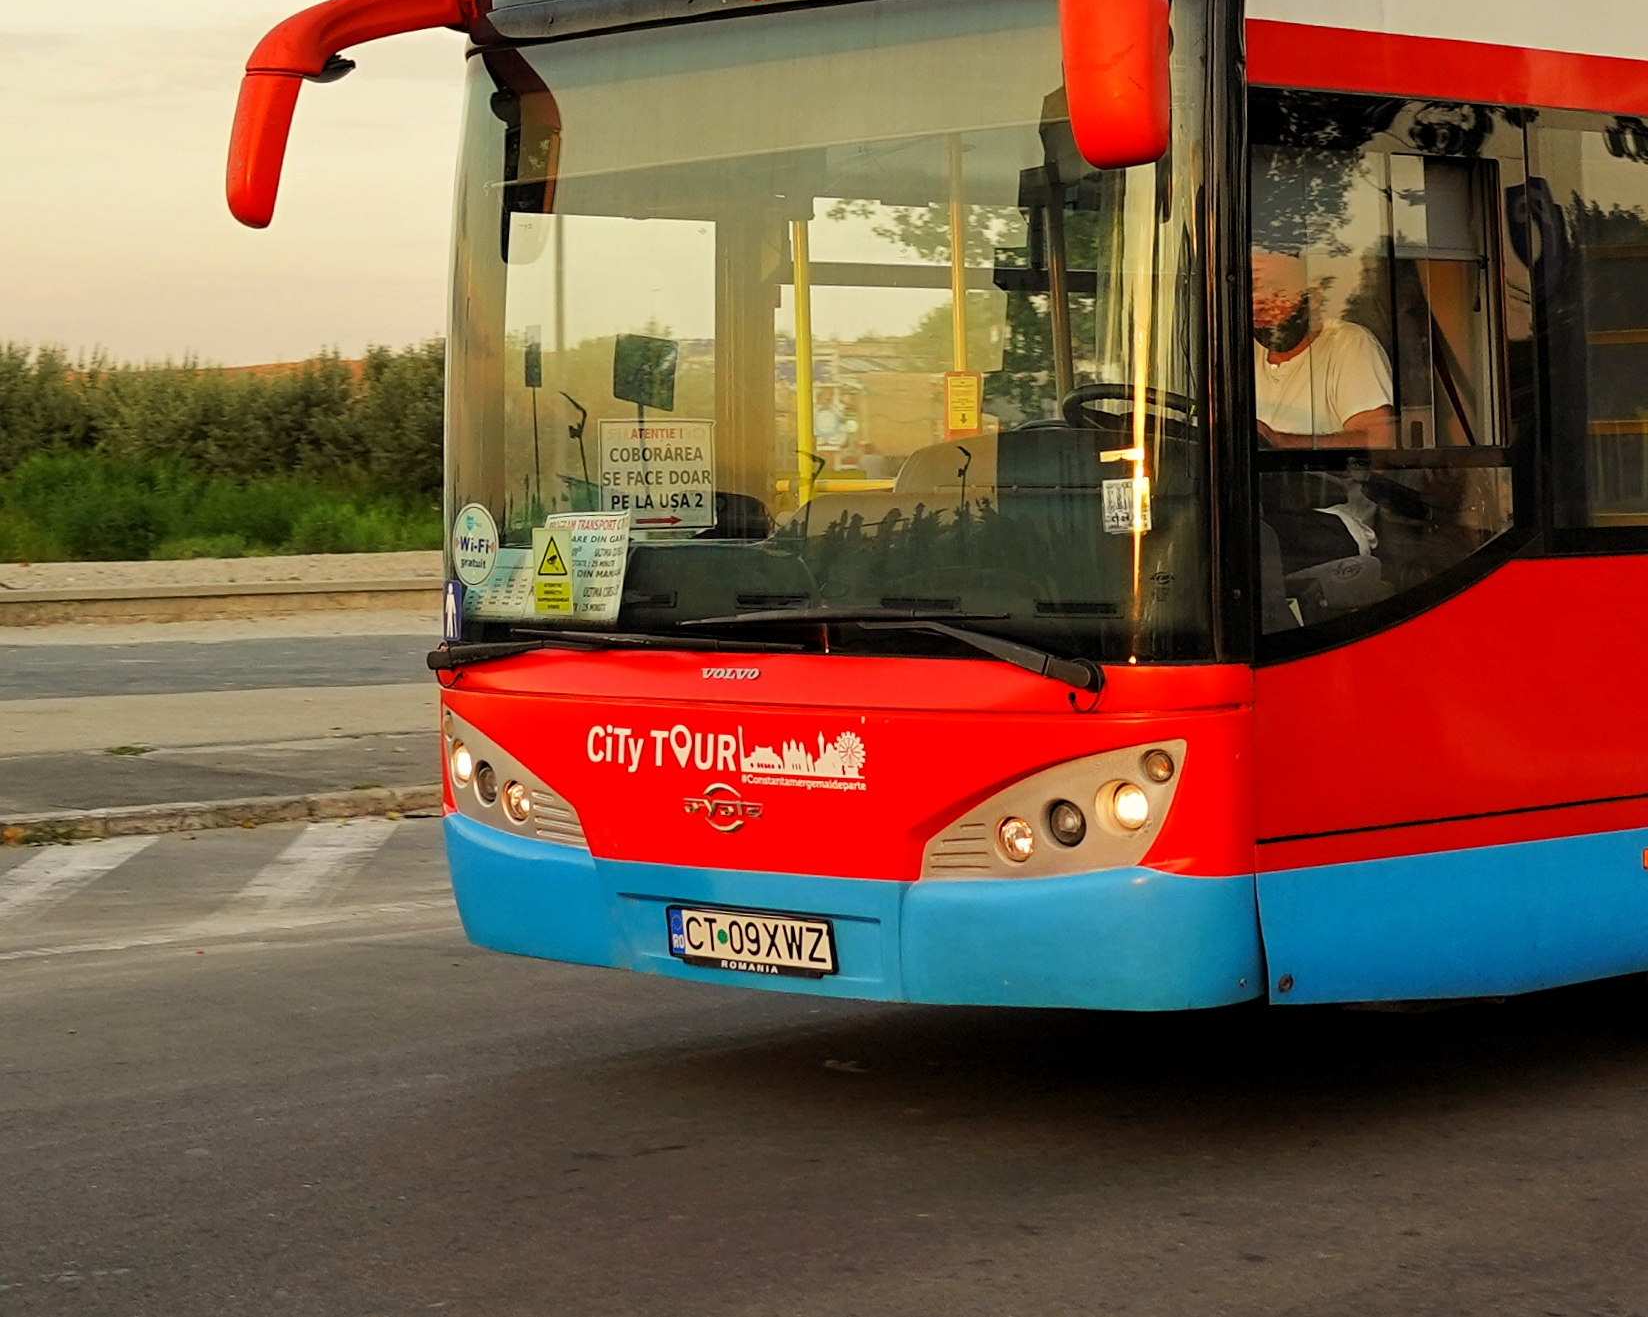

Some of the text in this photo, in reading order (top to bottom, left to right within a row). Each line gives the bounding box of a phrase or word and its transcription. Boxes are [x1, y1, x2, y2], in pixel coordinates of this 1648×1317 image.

[609, 443, 704, 463] COBORÂREA
[602, 469, 711, 487] SE FACE DOAR
[611, 494, 630, 510] PE
[635, 494, 654, 509] LA
[694, 492, 704, 508] 2
[577, 519, 617, 531] TRANSPORT
[460, 536, 490, 554] Wi-Fi
[590, 535, 607, 543] DIN
[460, 558, 486, 569] gratuit
[577, 569, 593, 578] DIN
[702, 667, 760, 680] VOLVO
[650, 724, 737, 772] TOUR
[672, 933, 685, 949] RO
[720, 959, 779, 974] ROMANIA
